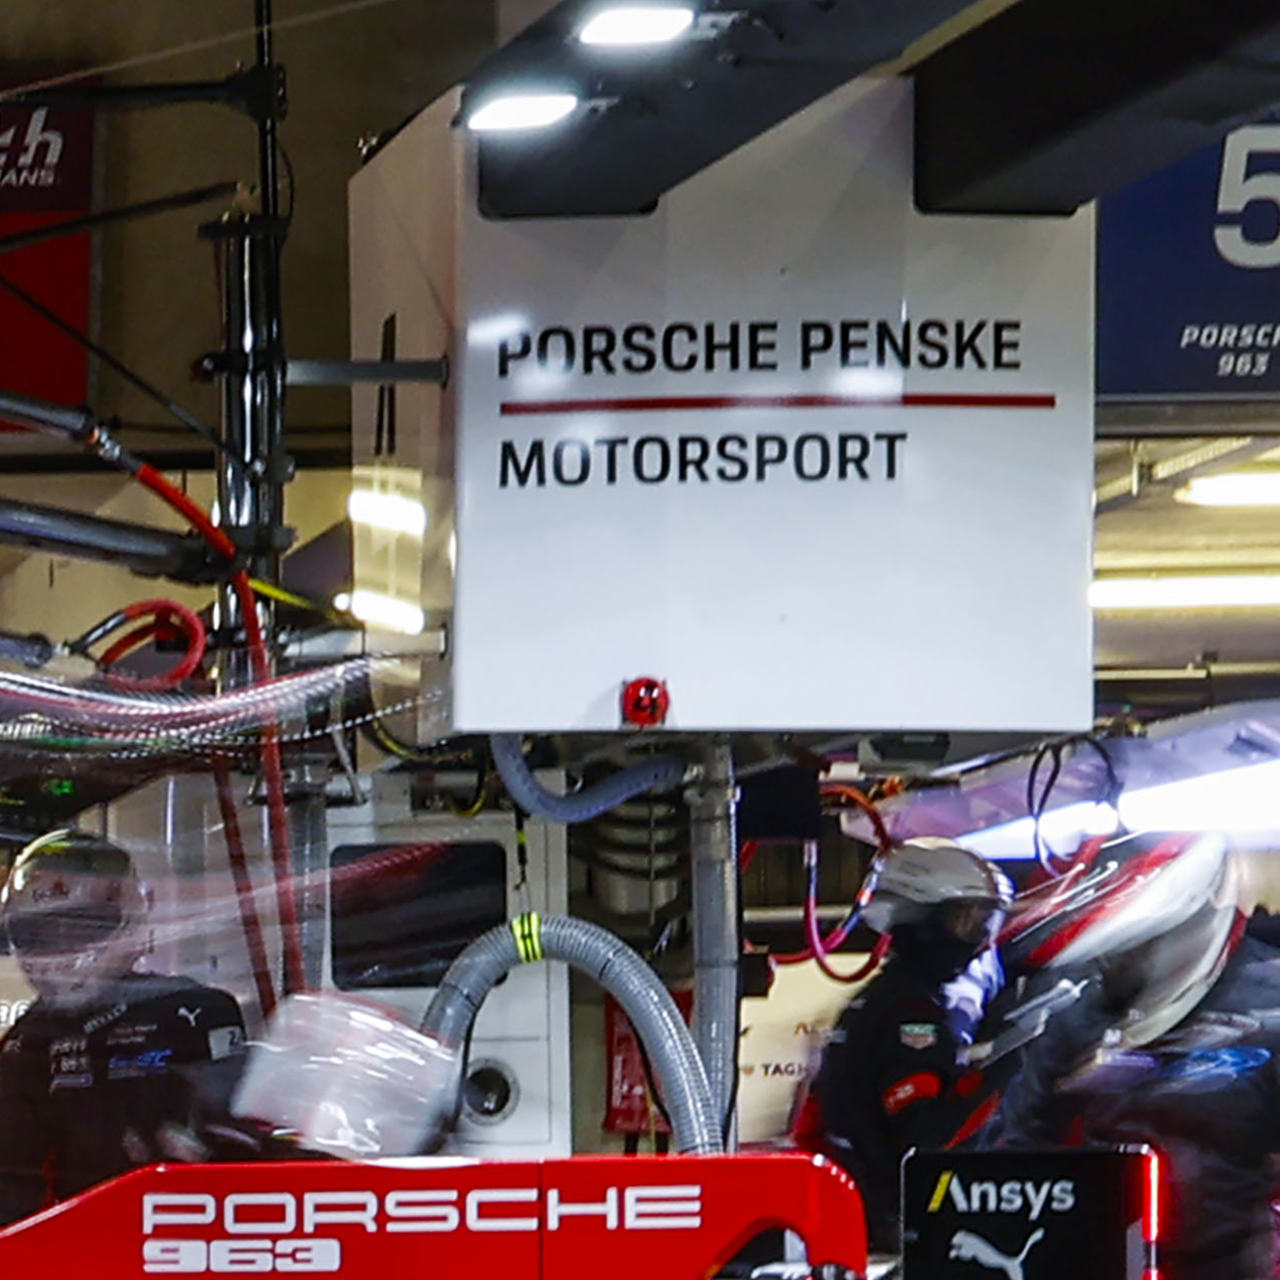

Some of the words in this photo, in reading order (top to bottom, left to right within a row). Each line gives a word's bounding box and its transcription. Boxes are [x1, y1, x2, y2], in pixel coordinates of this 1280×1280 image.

[497, 323, 778, 379] PORSCHE
[800, 319, 1023, 372] PENSKE
[1216, 353, 1270, 377] 963
[499, 432, 908, 489] MOTORSPORT
[142, 1184, 704, 1236] PORSCHE
[927, 1170, 1076, 1220] Ansys
[142, 1238, 341, 1274] 963
